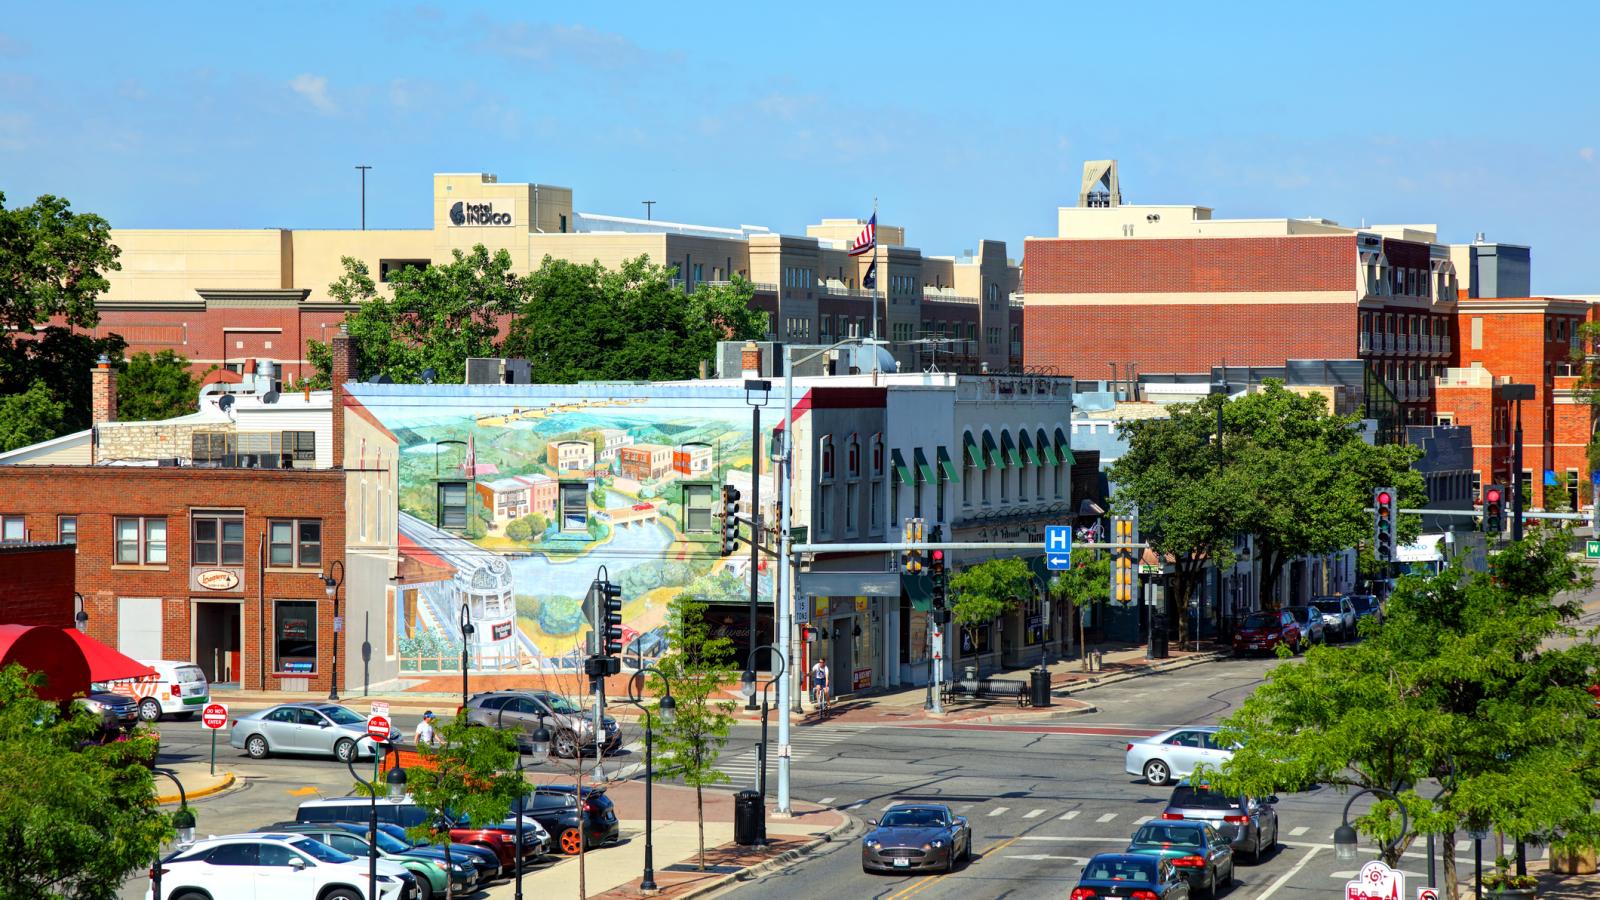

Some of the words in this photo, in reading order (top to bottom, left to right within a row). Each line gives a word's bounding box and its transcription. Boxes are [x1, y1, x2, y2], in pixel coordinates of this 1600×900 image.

[467, 202, 492, 213] hotel
[467, 212, 511, 225] INDIGO
[1051, 530, 1066, 549] H
[1590, 544, 1599, 553] W
